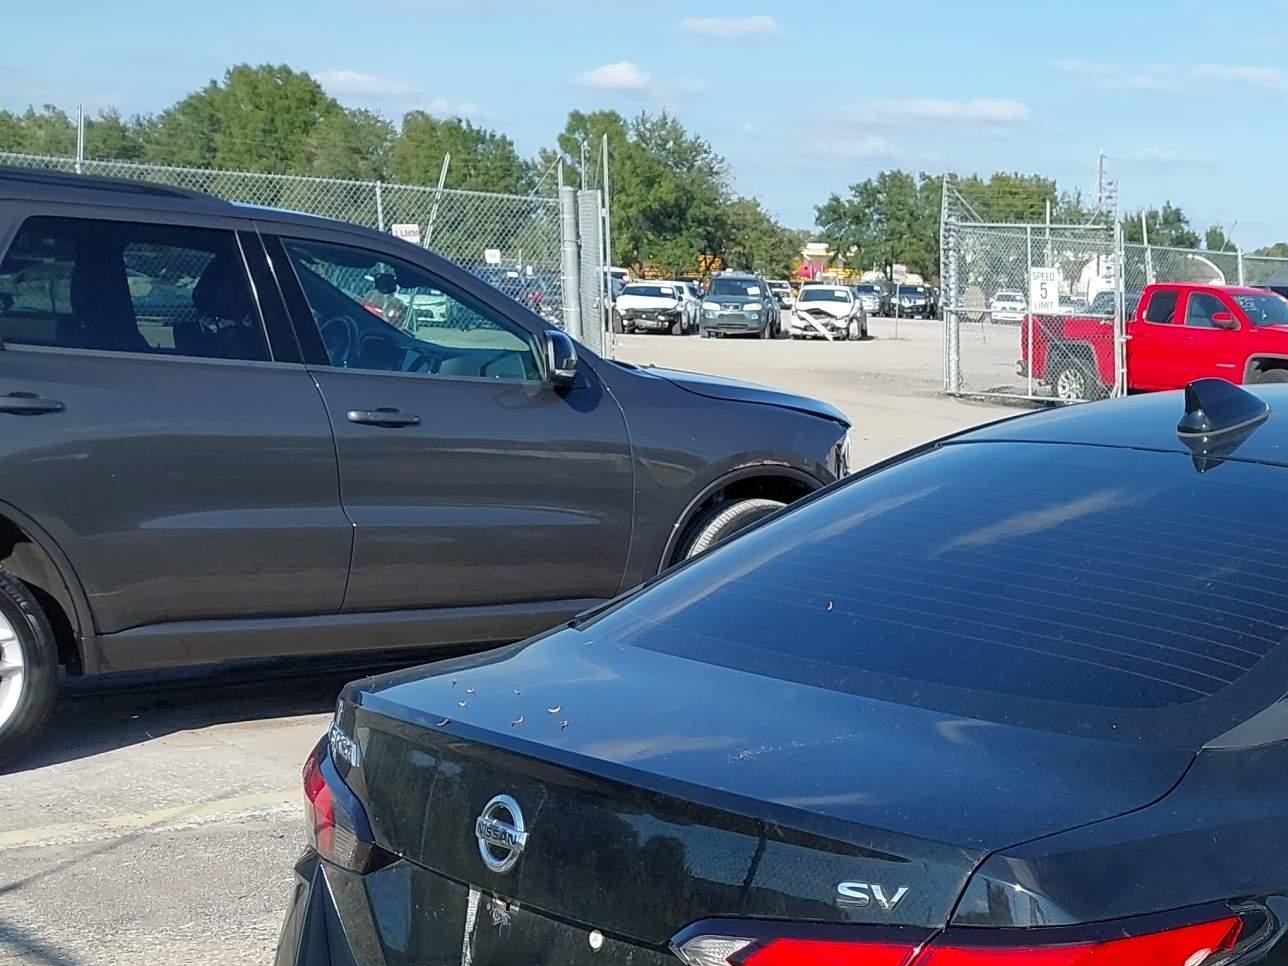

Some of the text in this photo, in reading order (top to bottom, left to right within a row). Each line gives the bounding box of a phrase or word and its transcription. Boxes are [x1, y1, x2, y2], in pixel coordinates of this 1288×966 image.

[1032, 271, 1055, 281] SPEED
[1040, 282, 1048, 299] 5
[1034, 301, 1053, 311] LIMIT
[480, 822, 518, 846] NISSAN
[836, 882, 909, 911] SV
